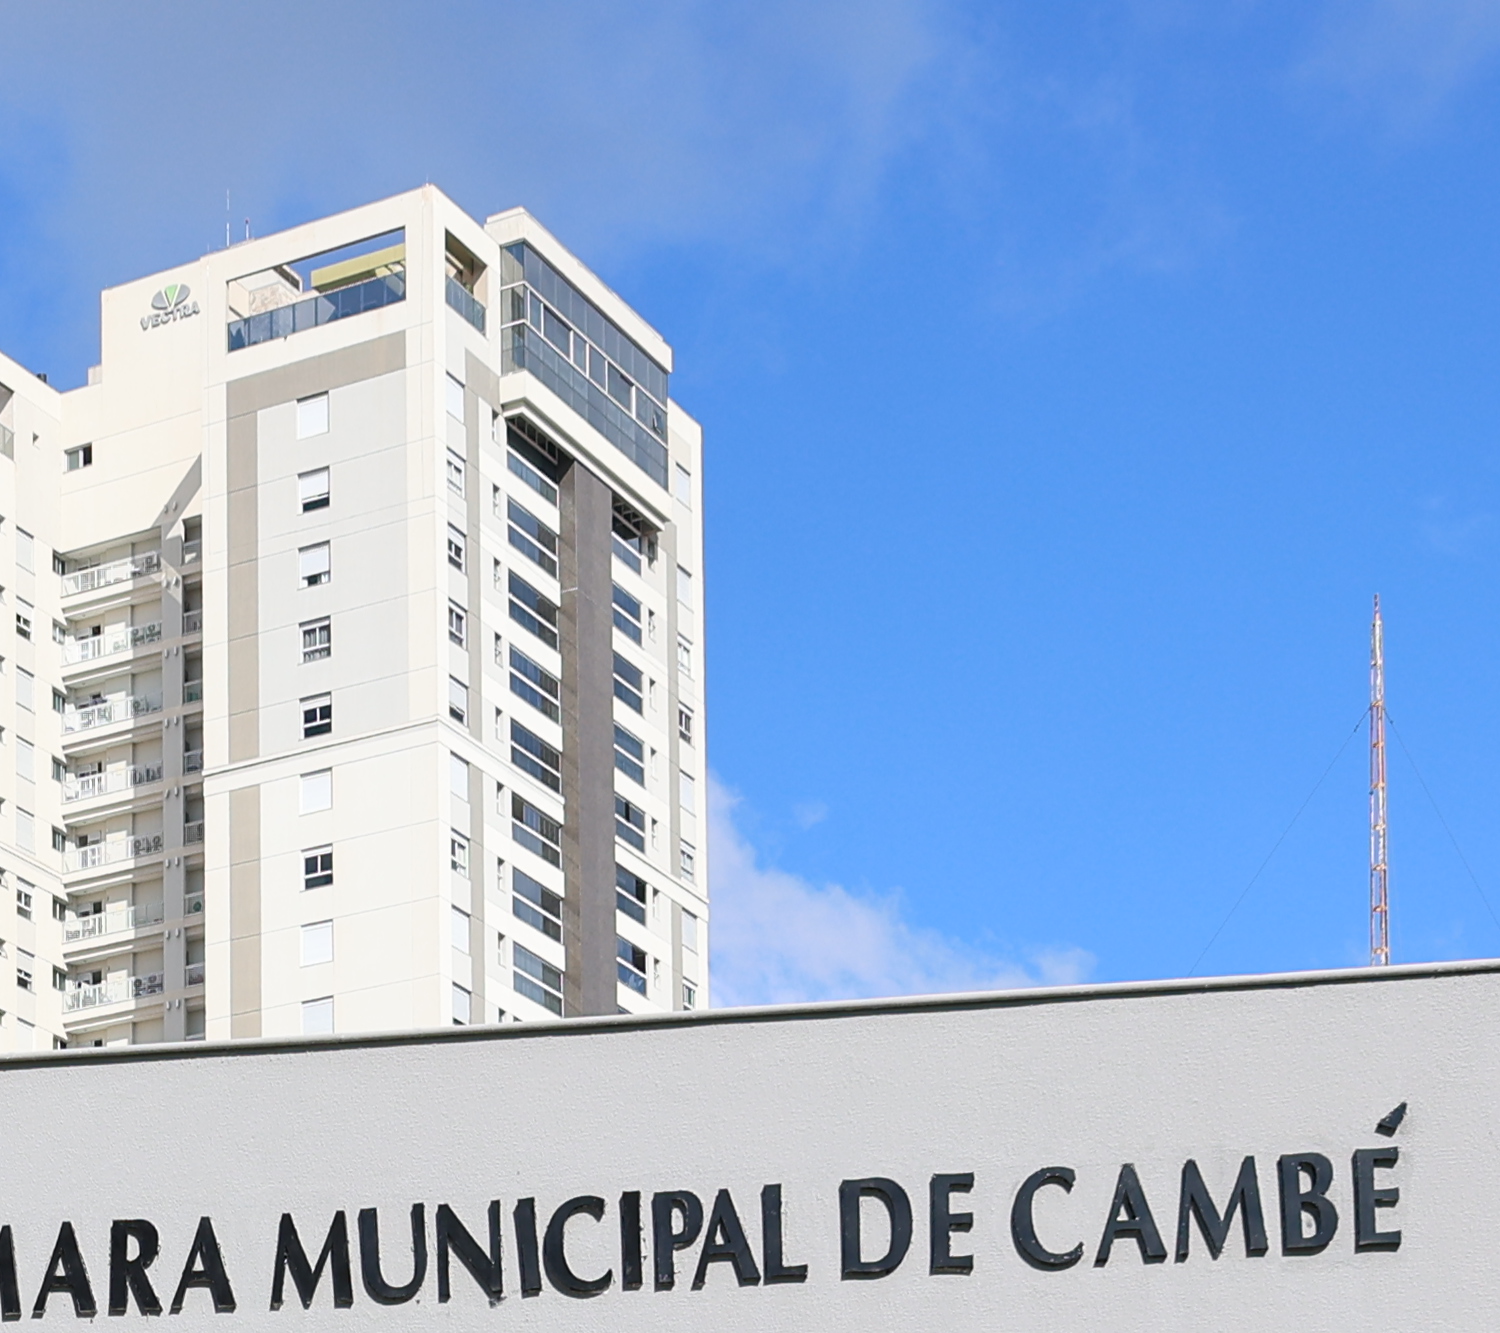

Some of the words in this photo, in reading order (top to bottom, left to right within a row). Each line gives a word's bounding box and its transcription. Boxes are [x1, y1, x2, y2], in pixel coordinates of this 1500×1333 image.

[140, 300, 201, 331] VECTRA
[269, 1183, 808, 1311] MUNICIPAL
[839, 1171, 974, 1281] DE
[1010, 1101, 1408, 1272] CAMBÉ
